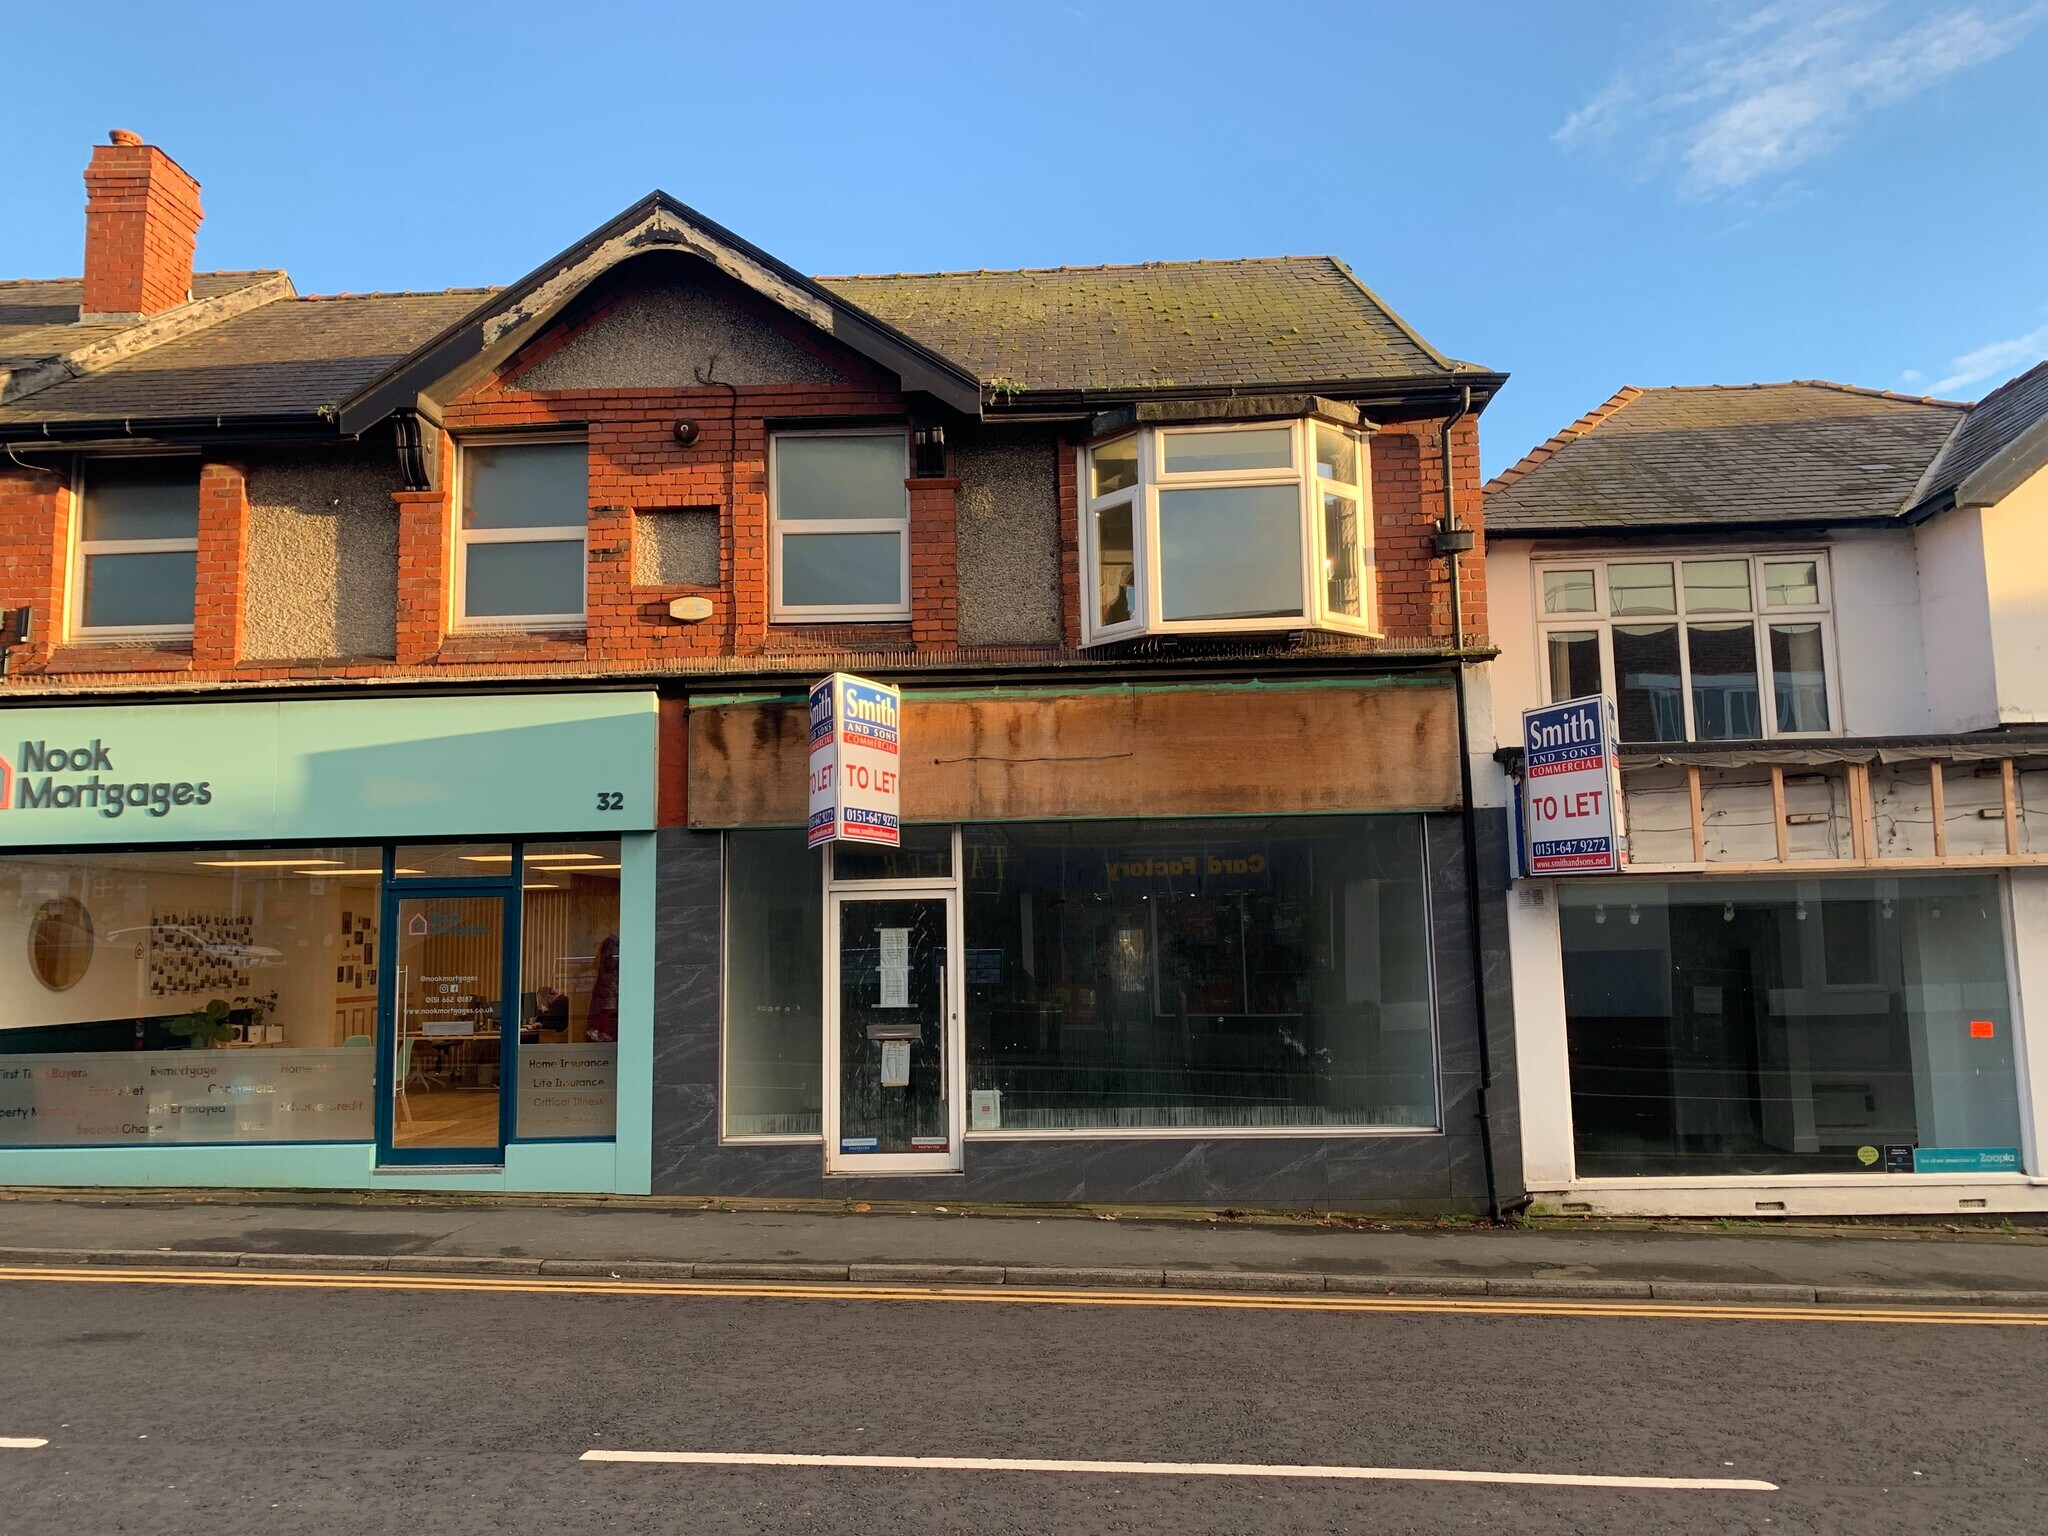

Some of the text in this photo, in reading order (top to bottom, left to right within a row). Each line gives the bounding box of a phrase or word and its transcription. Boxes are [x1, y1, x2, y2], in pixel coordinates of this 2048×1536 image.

[810, 688, 832, 729] mith
[846, 688, 896, 728] Smith
[847, 723, 896, 743] AND SONS
[1530, 708, 1596, 751] Smith
[847, 733, 897, 753] COMMERCIAL
[22, 739, 114, 772] Nook
[1532, 746, 1597, 765] AND SONS
[817, 764, 833, 792] LET
[1532, 760, 1599, 777] COMMERCIAL
[846, 764, 897, 796] TO LET
[19, 775, 212, 818] Mortgages
[596, 791, 624, 811] 32
[1532, 790, 1603, 821] TO LET
[846, 808, 897, 829] 0151-647 9272
[1535, 838, 1606, 856] 0151-647 9272
[1536, 855, 1607, 869] www.smithandsons.net
[420, 975, 478, 984] @nookmortgages
[403, 1007, 494, 1016] www.nookmortgages.co.uk
[281, 1064, 313, 1074] Home
[529, 1058, 609, 1069] Home Insurance
[52, 1067, 88, 1082] Buyers
[533, 1078, 604, 1088] Life Insurance
[1979, 1152, 2016, 1165] Zoopla
